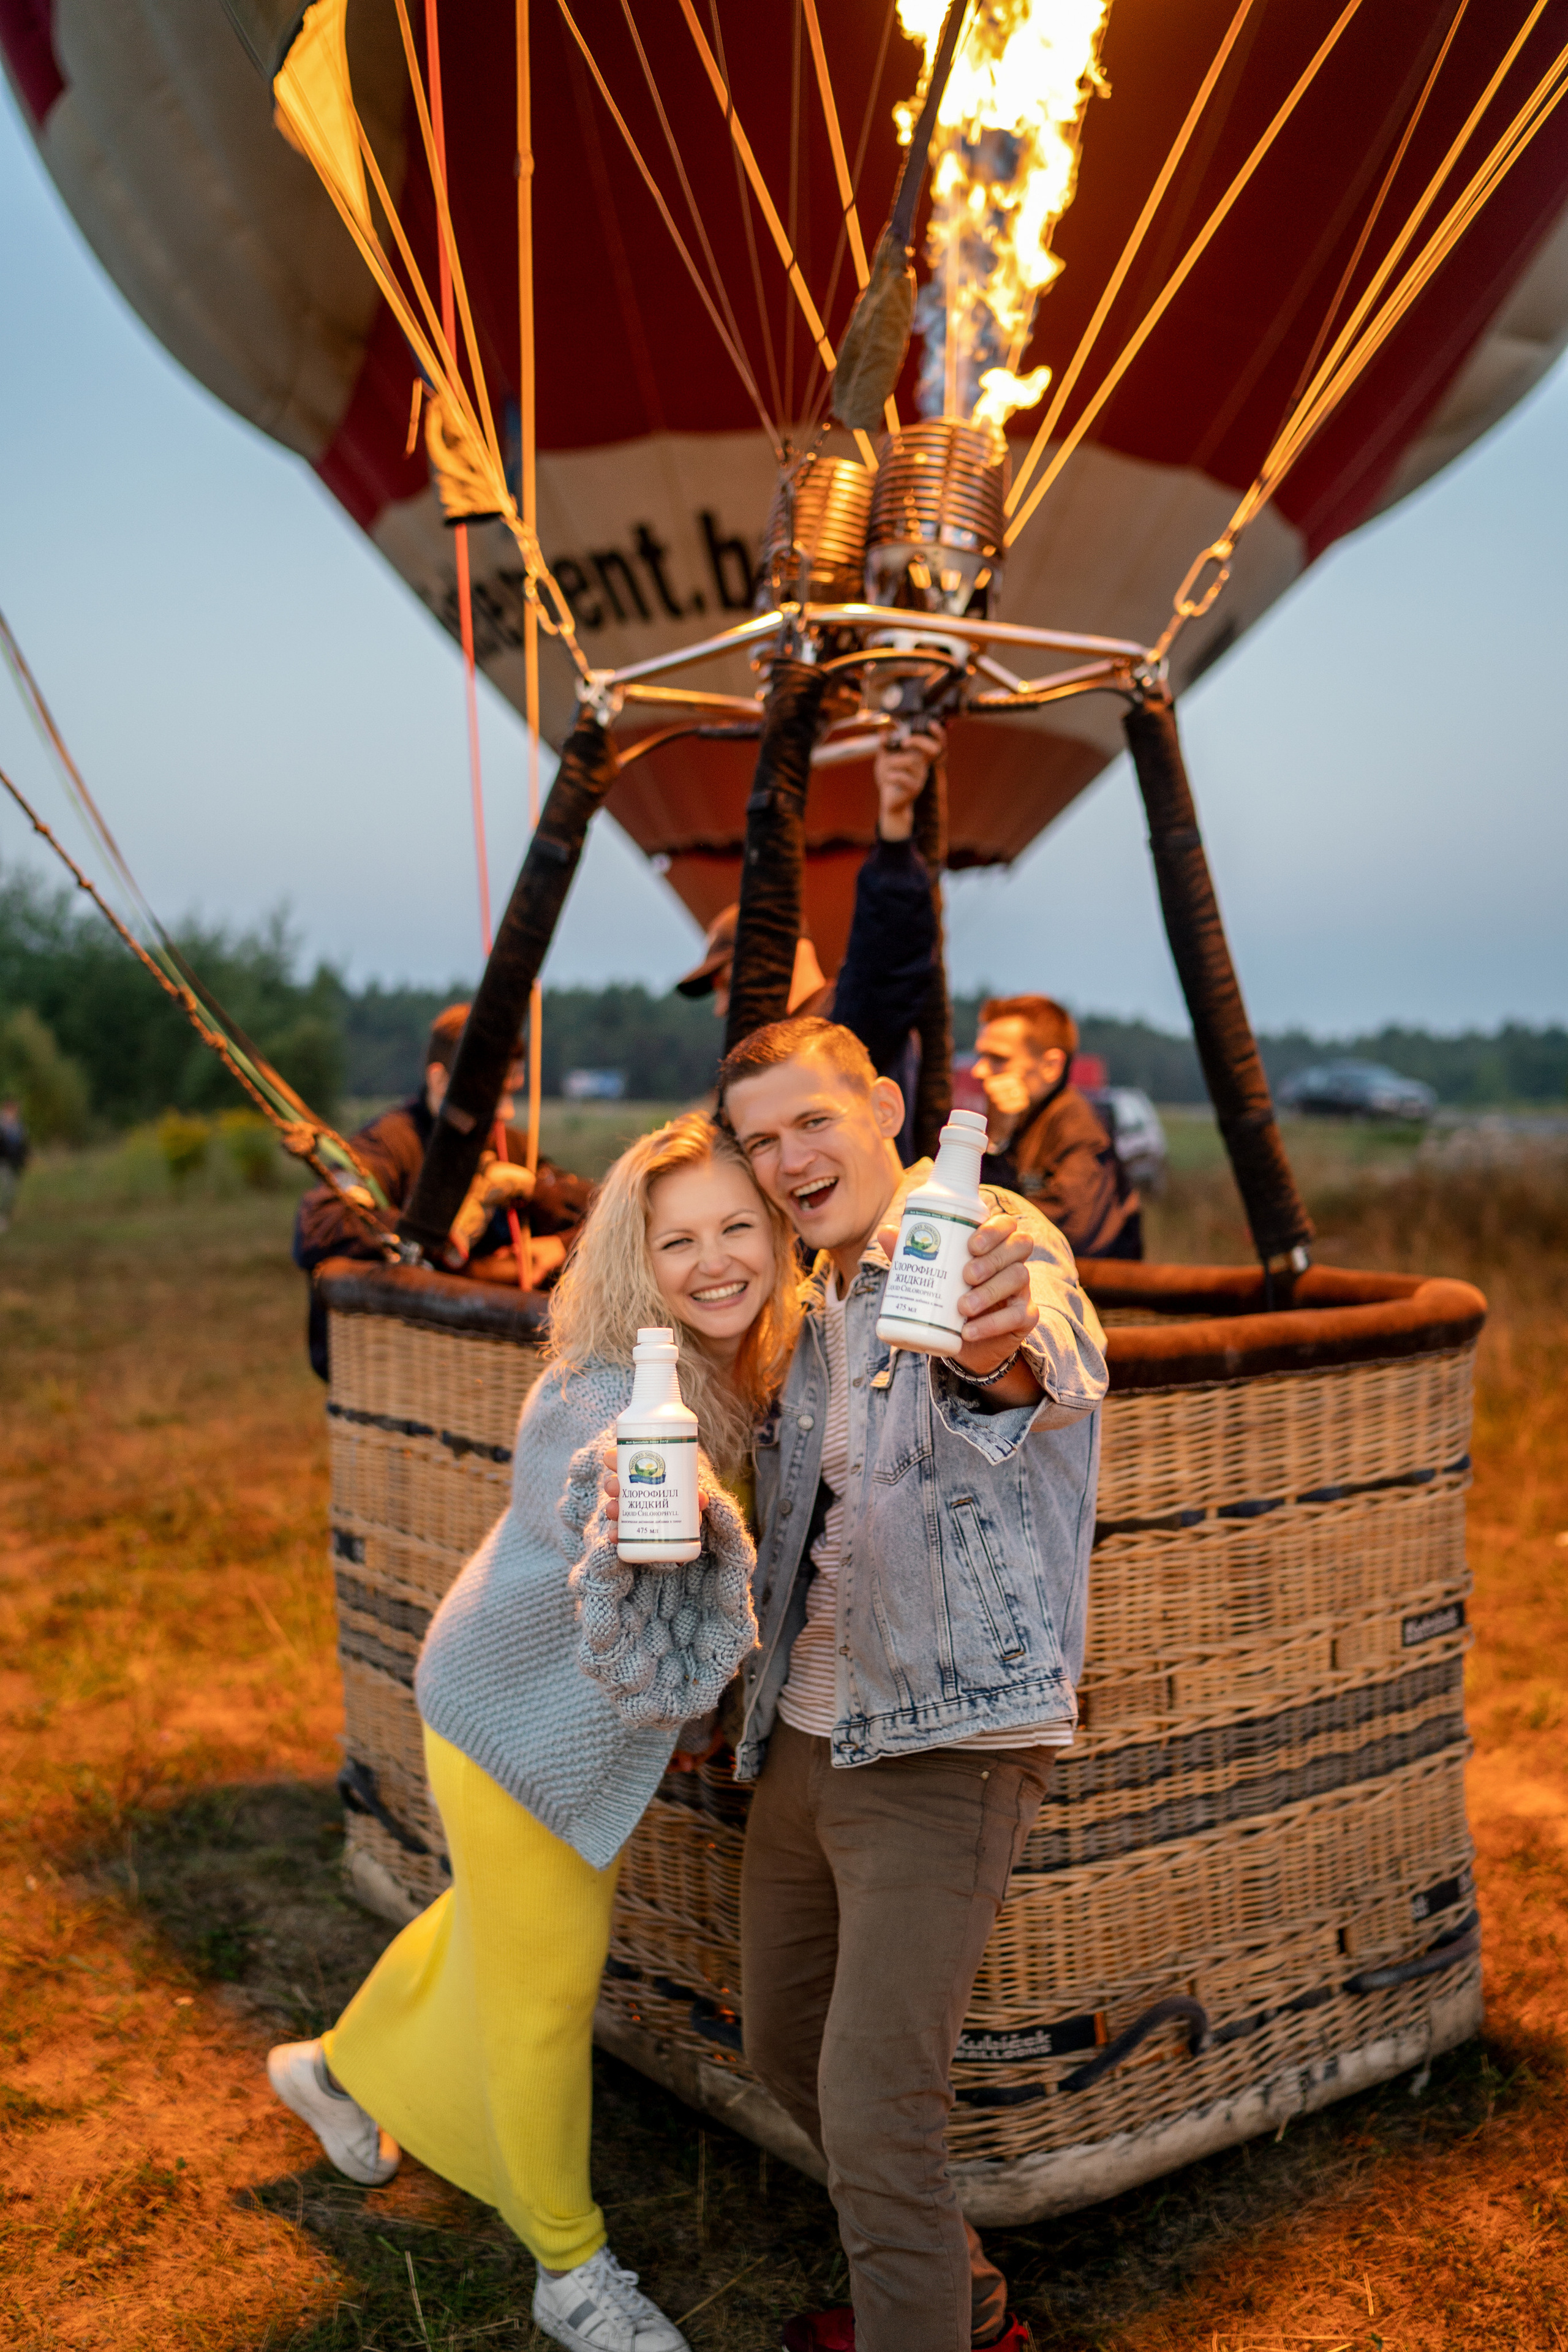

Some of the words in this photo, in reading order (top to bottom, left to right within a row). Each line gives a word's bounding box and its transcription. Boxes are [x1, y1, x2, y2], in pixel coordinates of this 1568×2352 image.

[895, 1273, 935, 1288] ЖИДКИЙ
[622, 1488, 679, 1498] ХЛОРОФИЛЛ
[628, 1498, 669, 1510] ЖИДКИЙ
